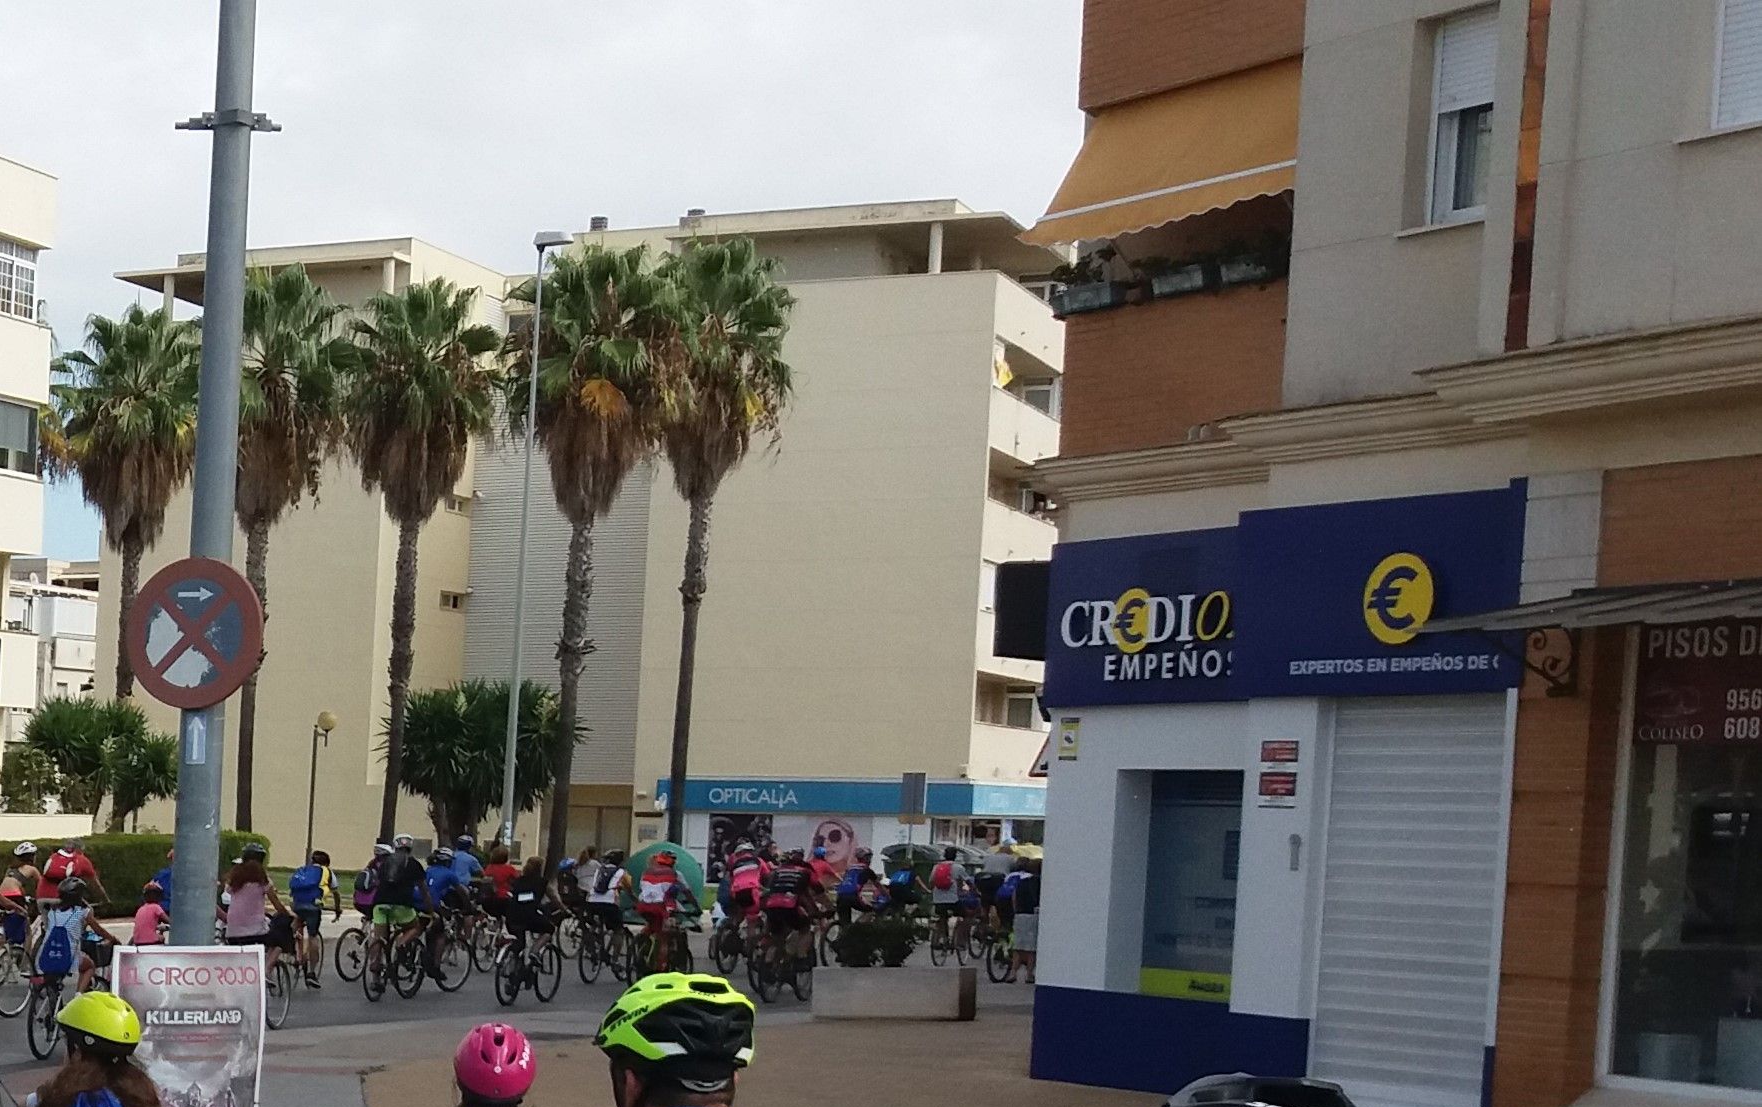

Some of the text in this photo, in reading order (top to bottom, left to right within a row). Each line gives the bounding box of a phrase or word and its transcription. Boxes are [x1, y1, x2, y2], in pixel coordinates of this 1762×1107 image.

[1648, 625, 1762, 658] PISOS D
[1289, 659, 1364, 675] EXPERTOS
[1367, 658, 1387, 672] EN
[1391, 653, 1464, 672] EMPEÑOS
[1468, 655, 1489, 669] DE
[1639, 723, 1704, 741] COLISEO
[147, 966, 212, 986] CIRCO
[214, 966, 258, 986] ROJO
[146, 1009, 242, 1025] KILLERLAND
